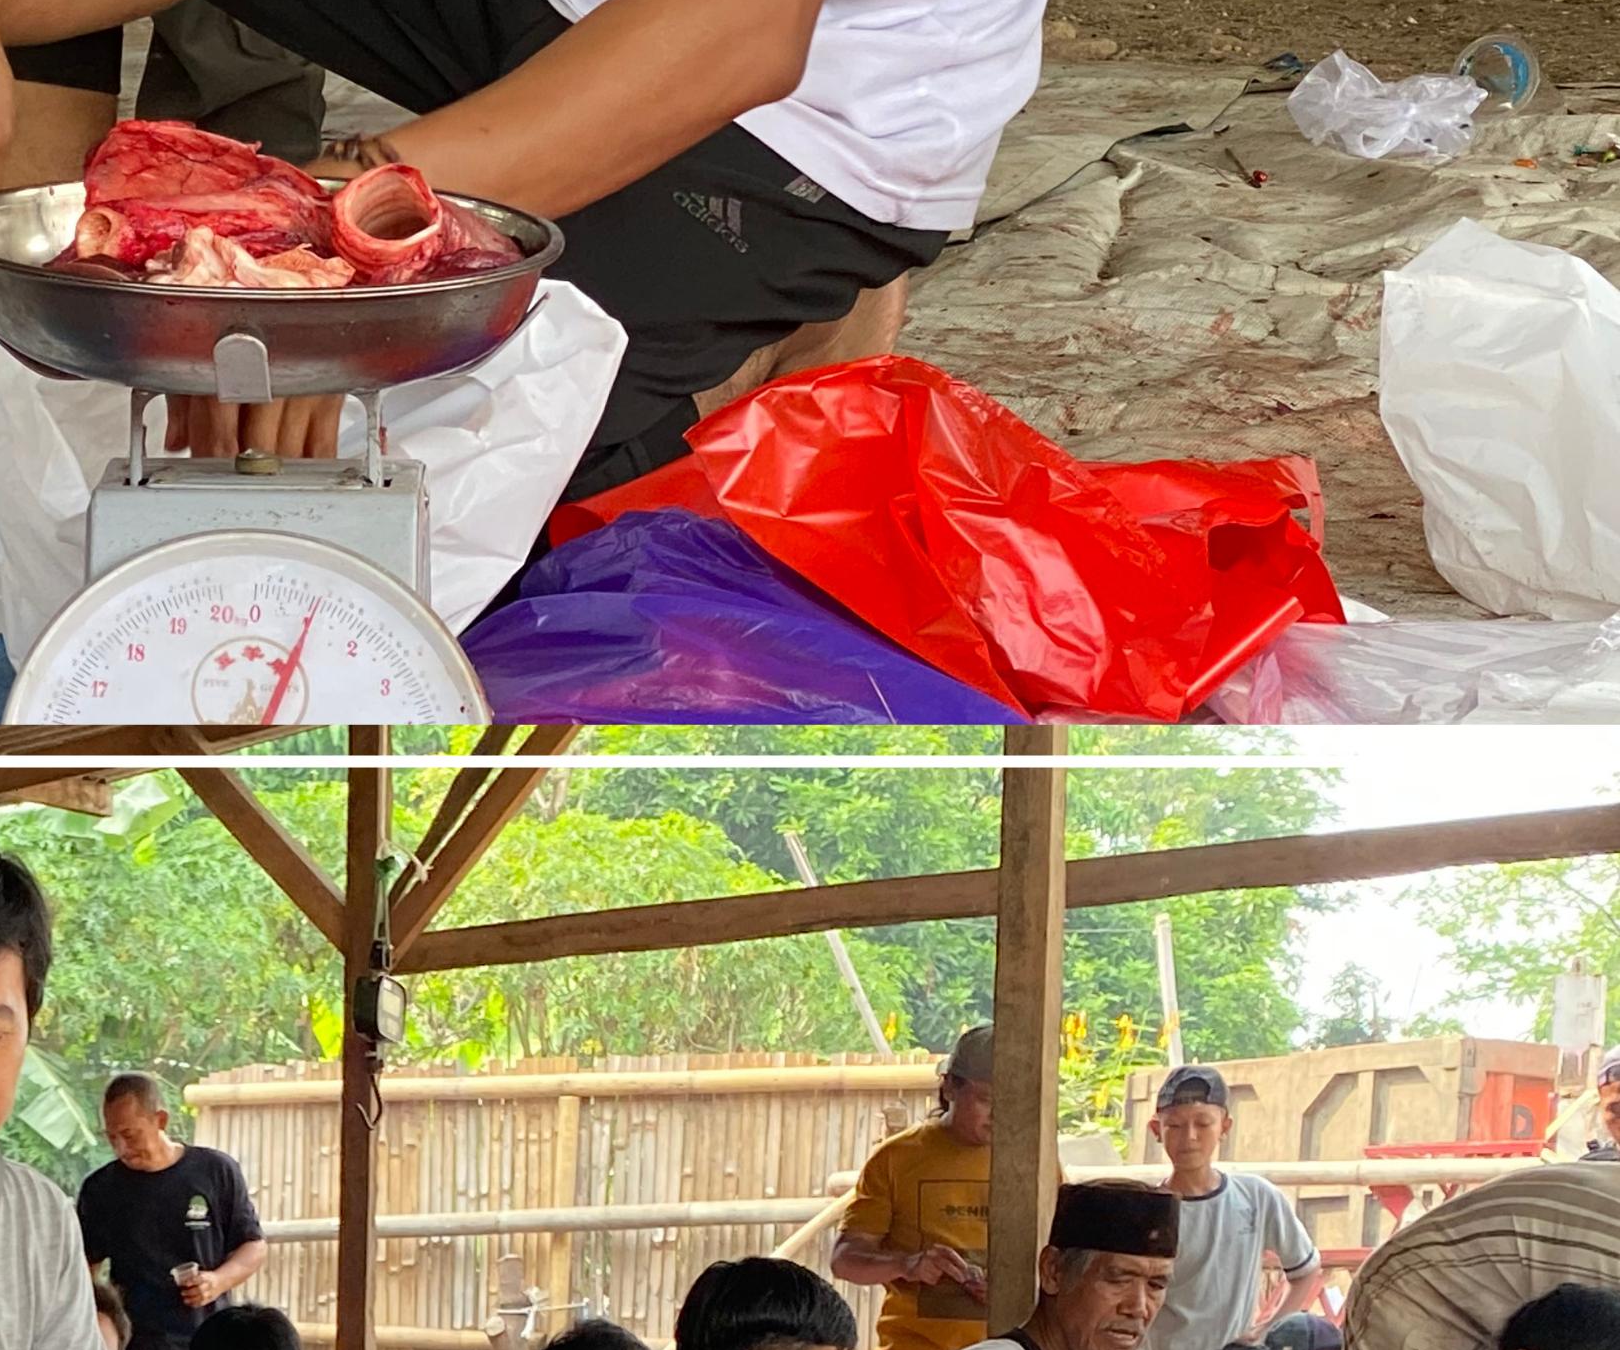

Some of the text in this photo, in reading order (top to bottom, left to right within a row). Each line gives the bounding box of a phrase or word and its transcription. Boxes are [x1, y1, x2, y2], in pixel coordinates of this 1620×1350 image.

[210, 604, 234, 624] 20
[249, 604, 261, 622] 0
[168, 617, 187, 635] 19
[125, 644, 145, 662] 18
[347, 641, 358, 657] 2
[90, 680, 108, 698] 17
[380, 678, 391, 696] 3
